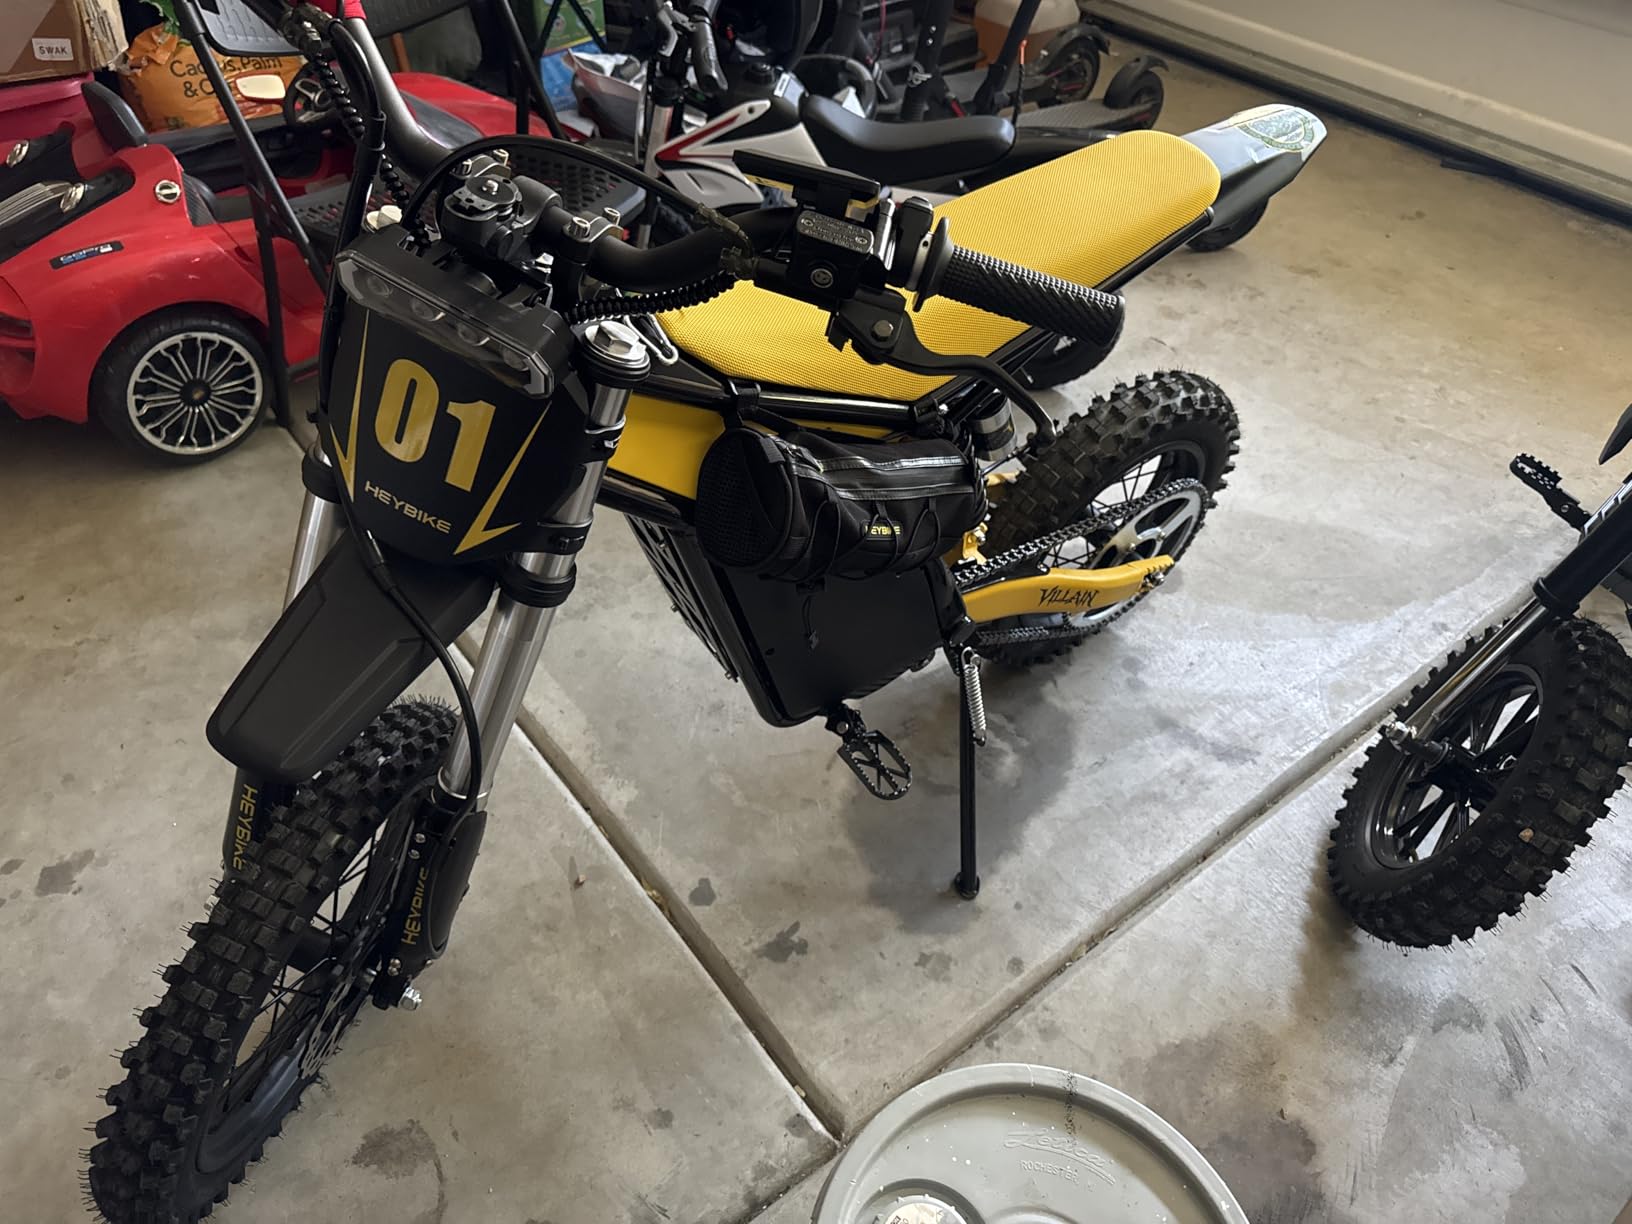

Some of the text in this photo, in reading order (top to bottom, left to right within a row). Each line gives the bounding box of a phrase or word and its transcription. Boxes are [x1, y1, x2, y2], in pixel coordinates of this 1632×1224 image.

[39, 45, 67, 55] SWAK
[374, 358, 497, 492] 01
[364, 480, 452, 534] HEYBIKE
[864, 524, 901, 536] EYBIE
[1038, 584, 1100, 608] VILLAIN
